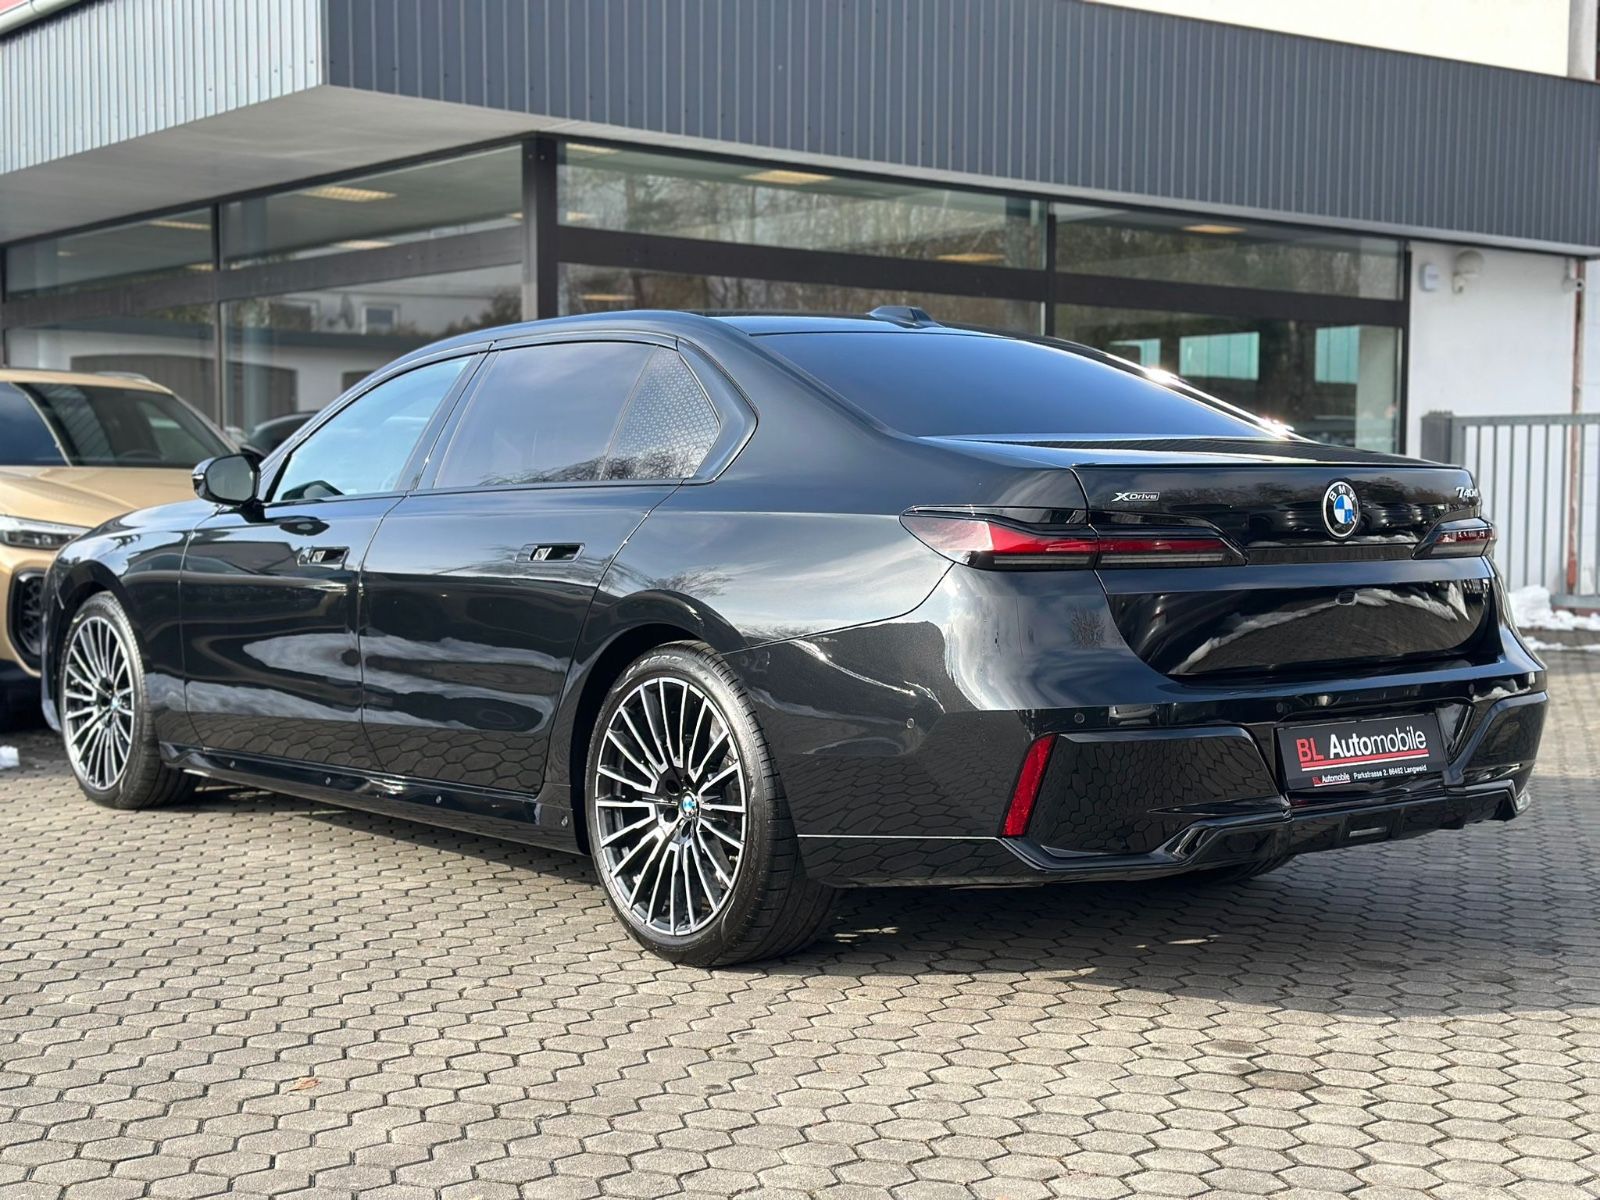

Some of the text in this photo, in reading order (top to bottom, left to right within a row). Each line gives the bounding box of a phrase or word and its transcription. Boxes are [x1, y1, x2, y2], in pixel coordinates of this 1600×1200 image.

[1329, 485, 1356, 501] BMW
[1296, 726, 1427, 762] BL Automobile
[1322, 772, 1351, 783] Automobile
